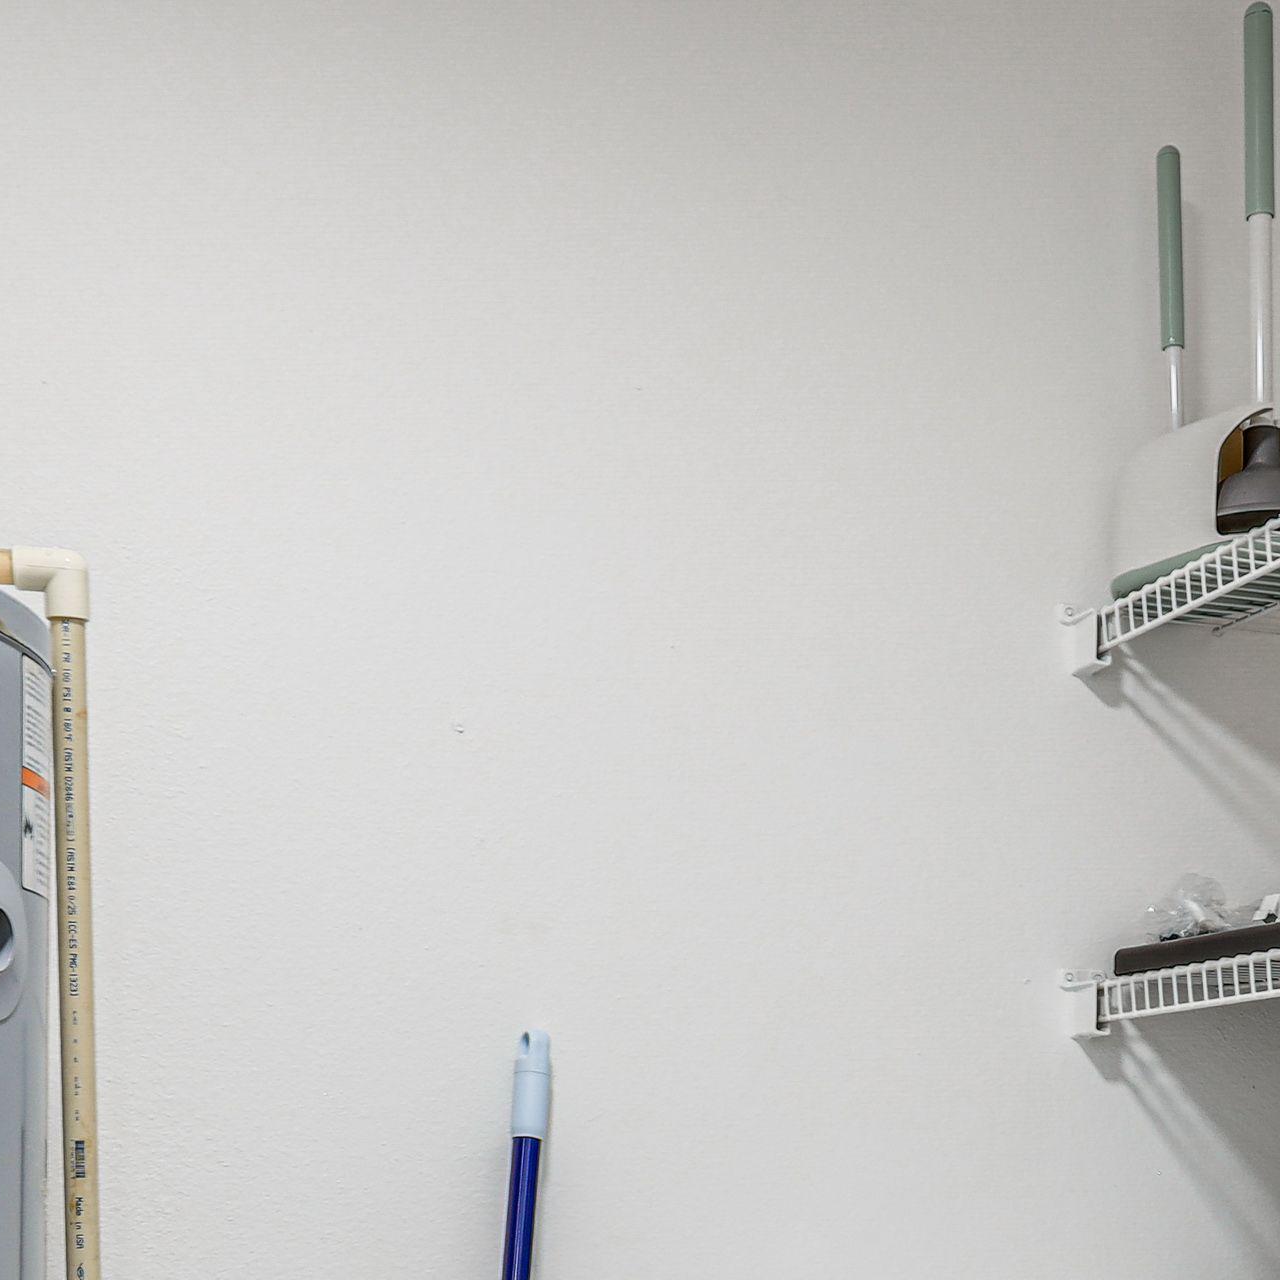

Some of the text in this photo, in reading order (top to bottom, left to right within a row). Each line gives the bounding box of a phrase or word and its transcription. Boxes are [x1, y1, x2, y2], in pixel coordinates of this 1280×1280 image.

[63, 652, 72, 663] PR
[63, 668, 72, 683] 100
[63, 687, 72, 702] PSI
[67, 876, 76, 891] E84
[68, 920, 78, 949] ICC-ES
[75, 1197, 85, 1249] Made in USA
